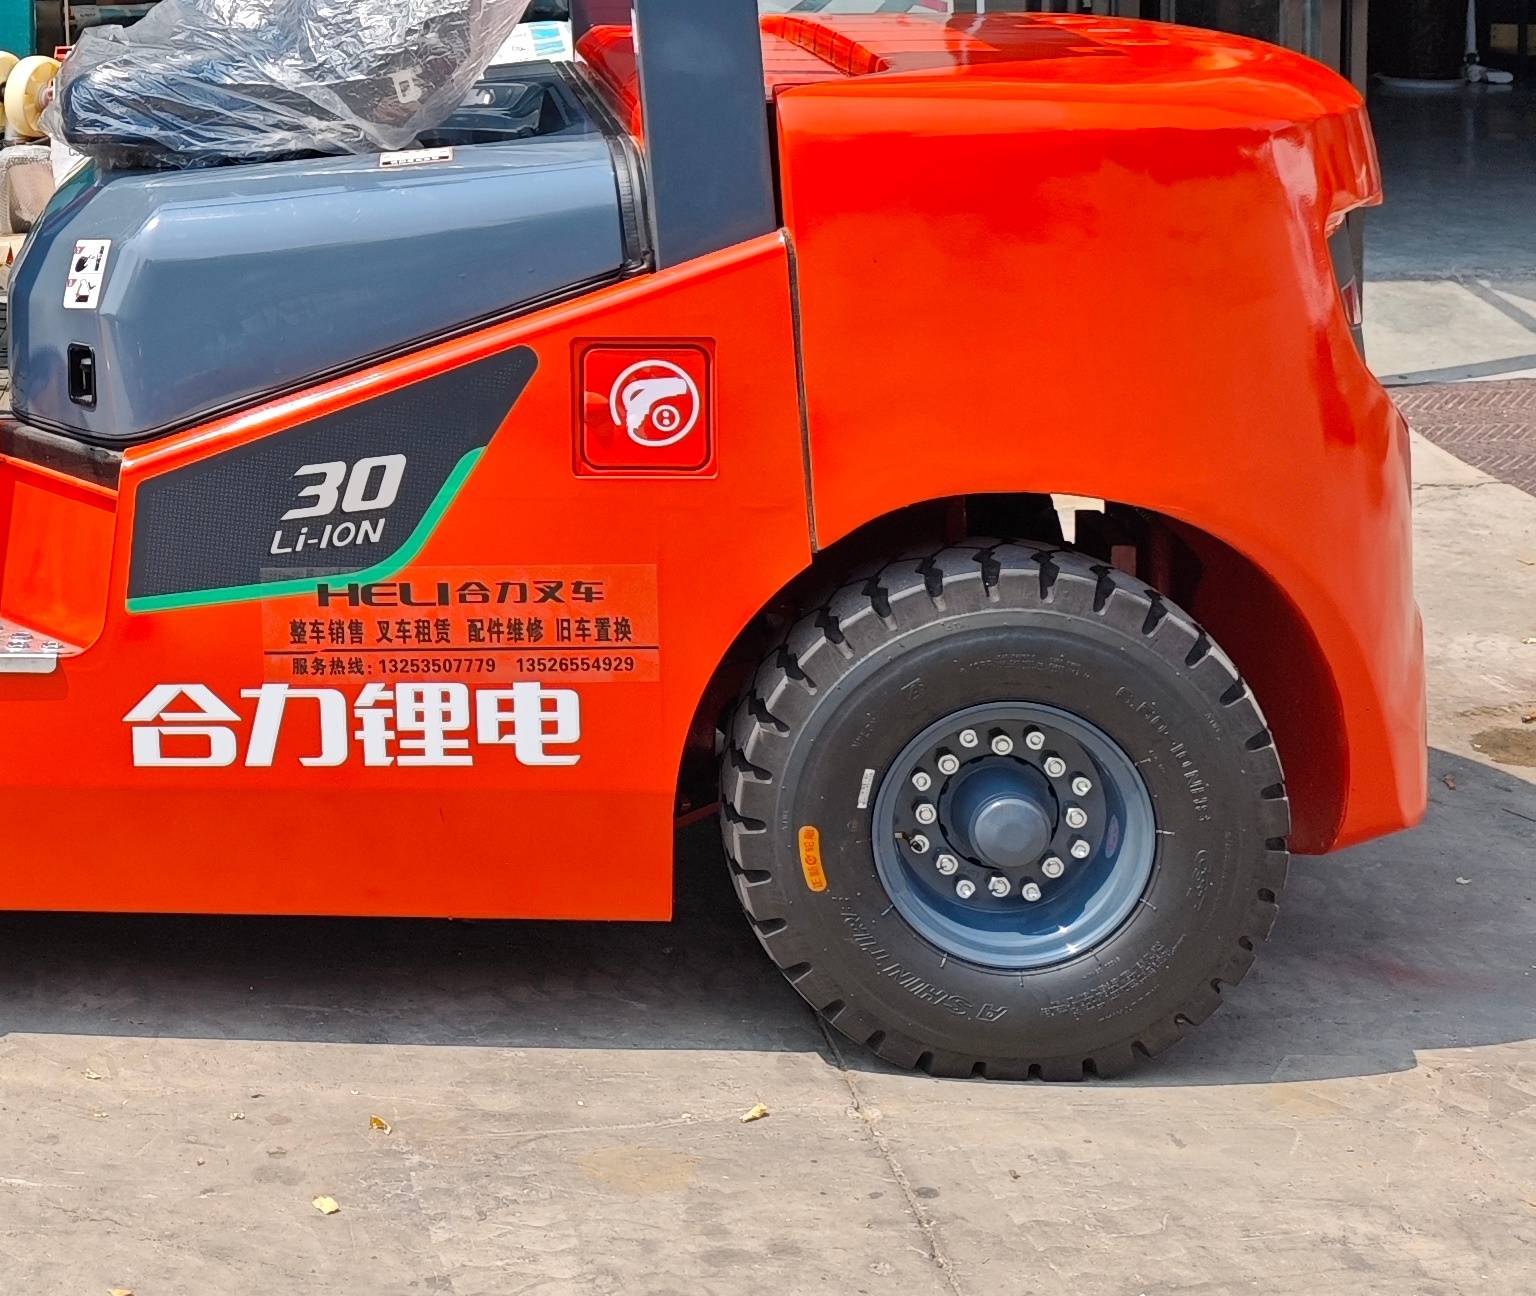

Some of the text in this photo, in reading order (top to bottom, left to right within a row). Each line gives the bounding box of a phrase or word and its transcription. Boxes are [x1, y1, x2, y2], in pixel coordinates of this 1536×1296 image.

[280, 453, 407, 520] 30
[270, 517, 386, 554] Li-ION
[316, 580, 605, 607] HELI 合力叉车
[289, 617, 632, 645] 整车销售 叉车租赁 配件维修 旧车置换
[379, 657, 496, 674] 13253507779
[516, 656, 635, 674] 13526554929
[122, 681, 581, 767] 合力锂电
